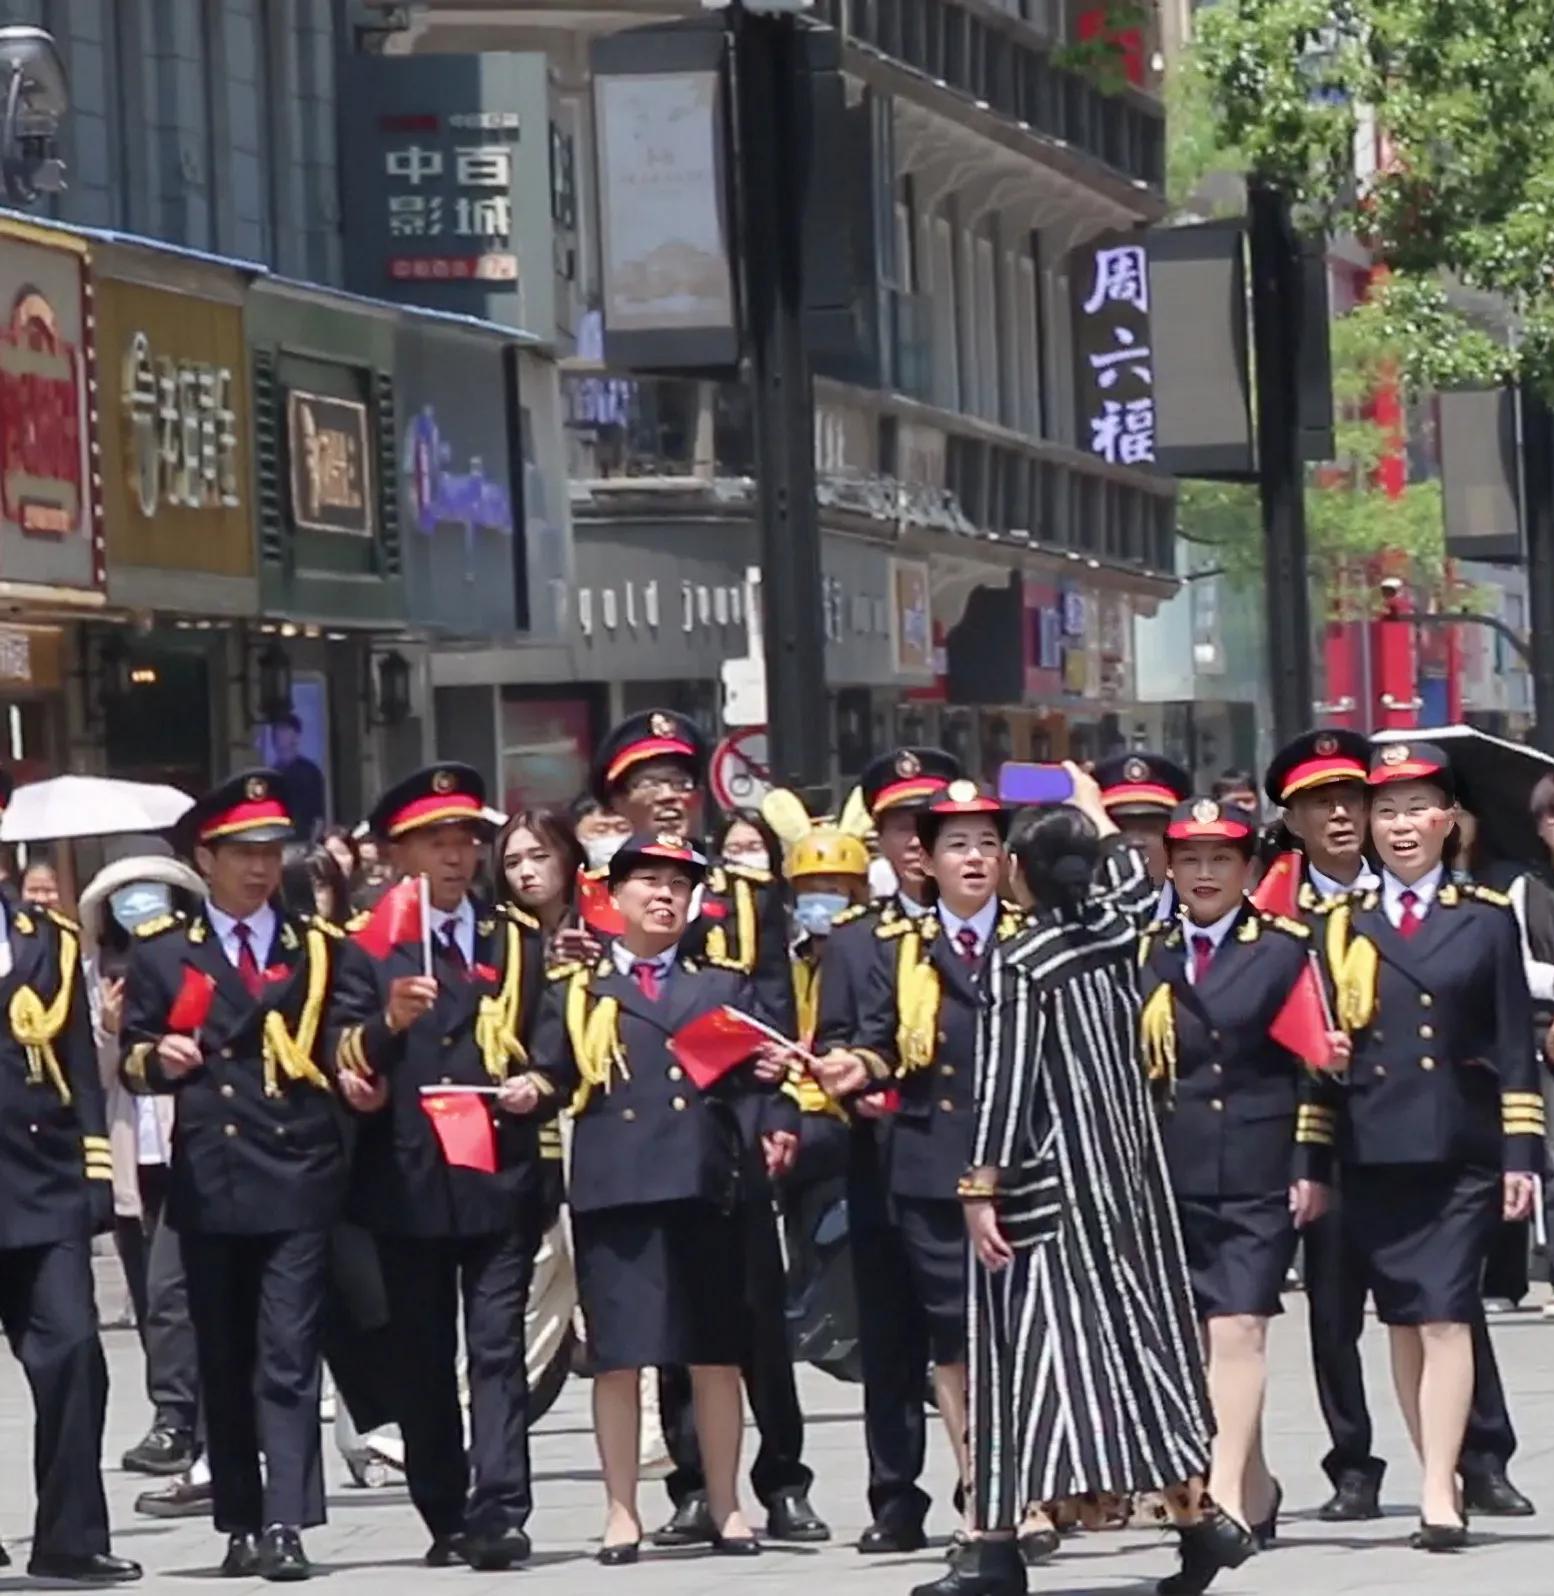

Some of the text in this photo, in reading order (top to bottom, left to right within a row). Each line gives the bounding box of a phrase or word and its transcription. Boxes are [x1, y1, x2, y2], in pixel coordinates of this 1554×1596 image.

[386, 146, 511, 186] 中百
[388, 196, 511, 236] 影城
[1084, 245, 1156, 465] 周六福
[579, 580, 658, 636] gold
